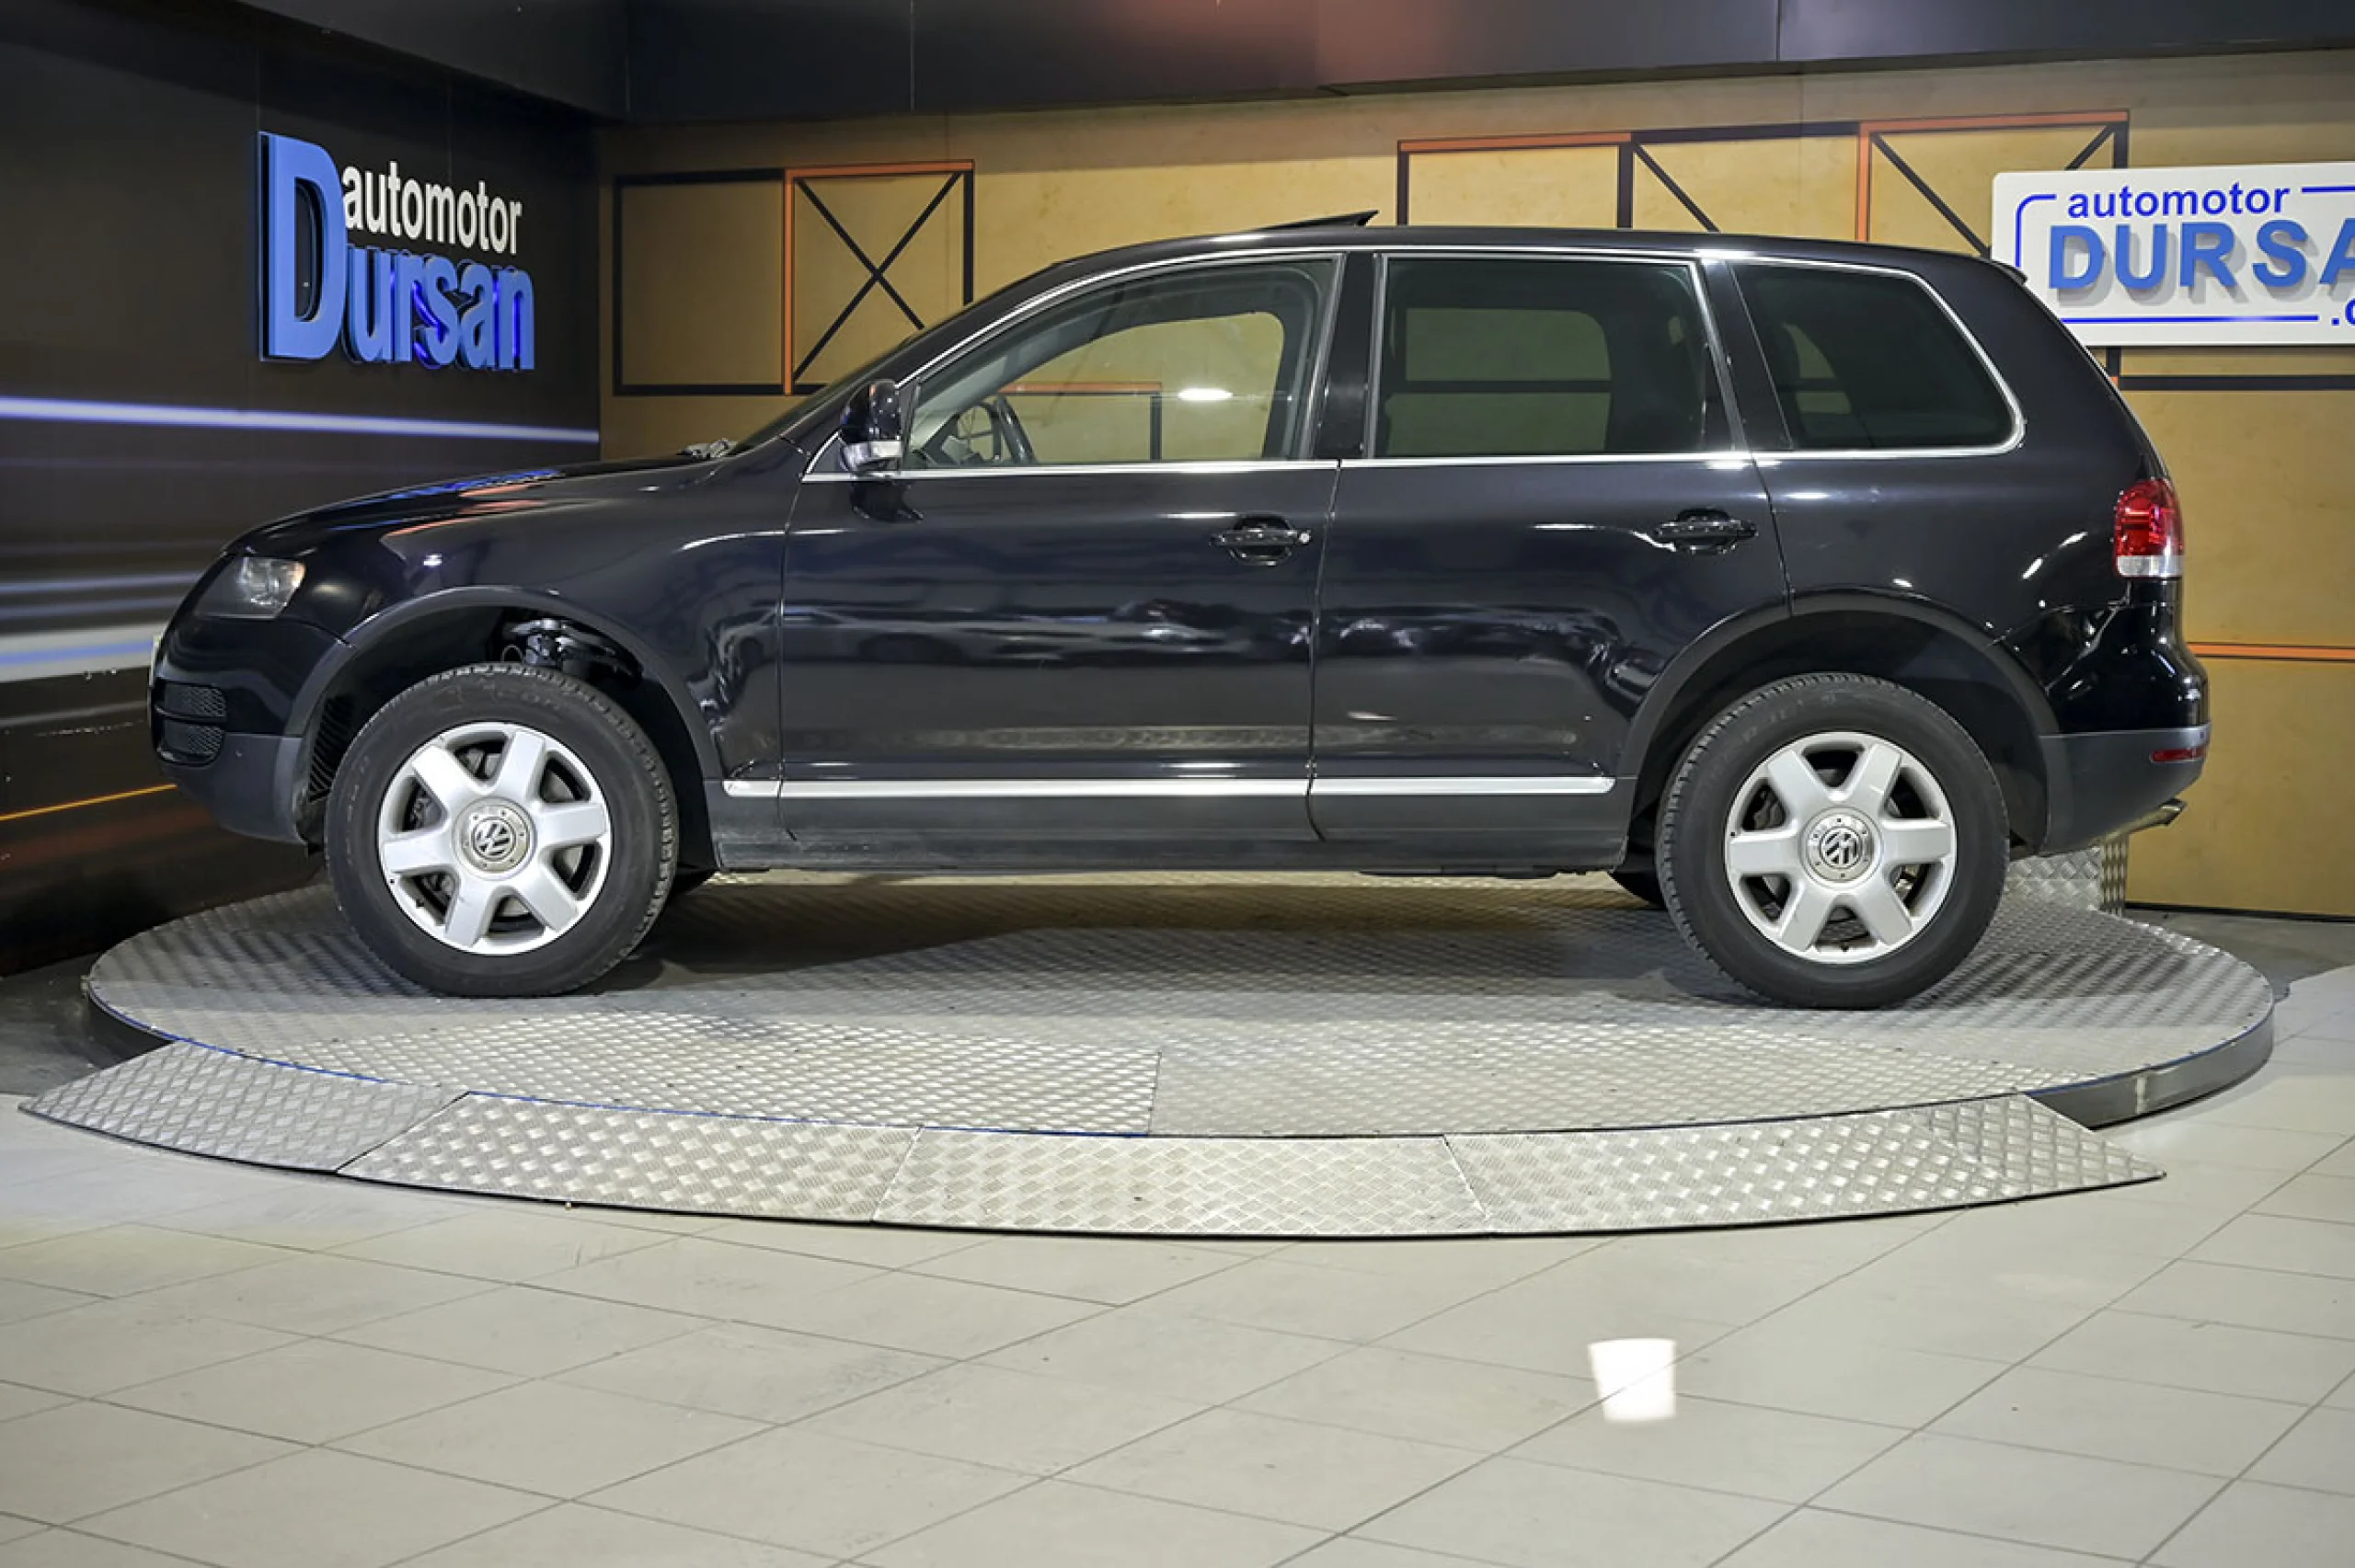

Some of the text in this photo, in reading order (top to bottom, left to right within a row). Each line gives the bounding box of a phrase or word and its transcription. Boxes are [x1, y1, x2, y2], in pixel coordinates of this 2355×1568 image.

[342, 161, 523, 255] automotor
[2067, 182, 2290, 218] automotor
[259, 132, 534, 370] Dursan
